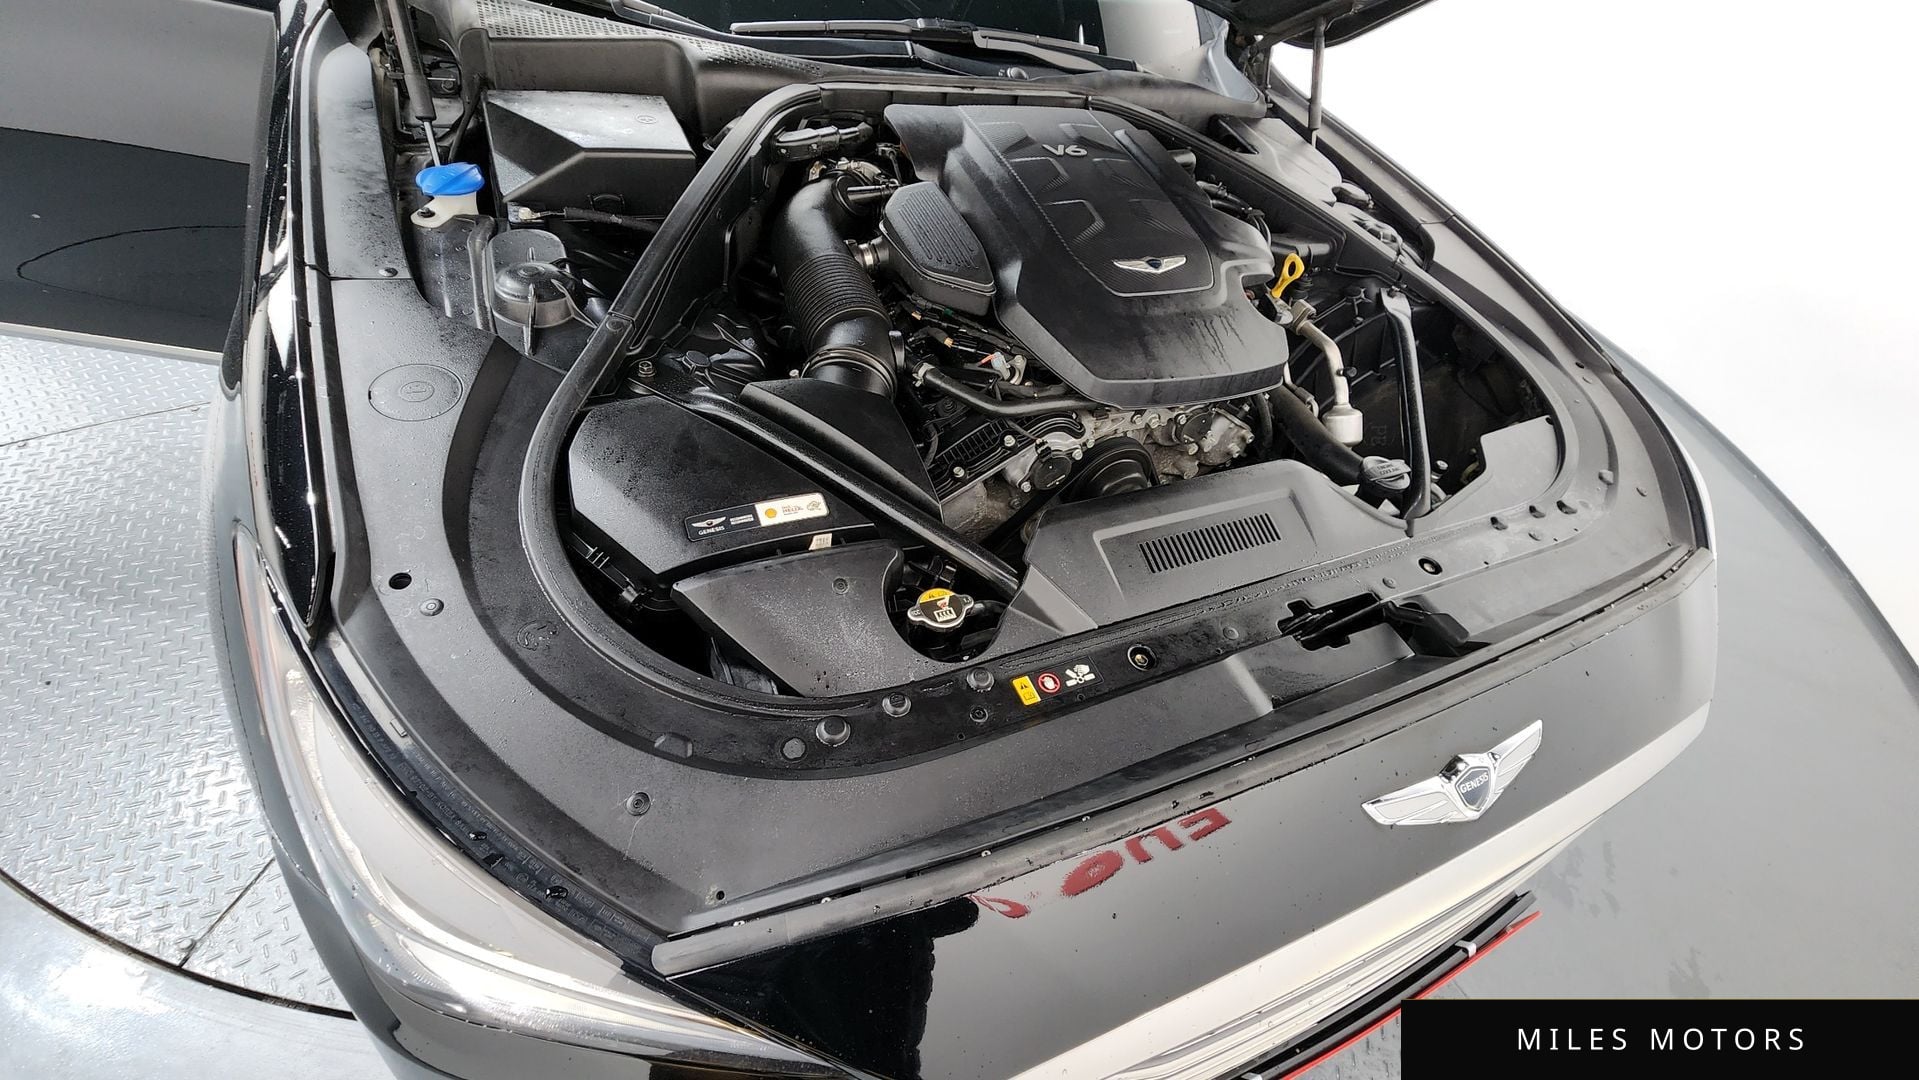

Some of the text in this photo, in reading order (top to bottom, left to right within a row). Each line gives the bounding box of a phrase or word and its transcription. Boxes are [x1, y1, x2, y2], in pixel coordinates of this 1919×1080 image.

[1042, 144, 1088, 156] V6
[698, 525, 725, 536] GENESIS
[1460, 772, 1489, 794] GENESIS
